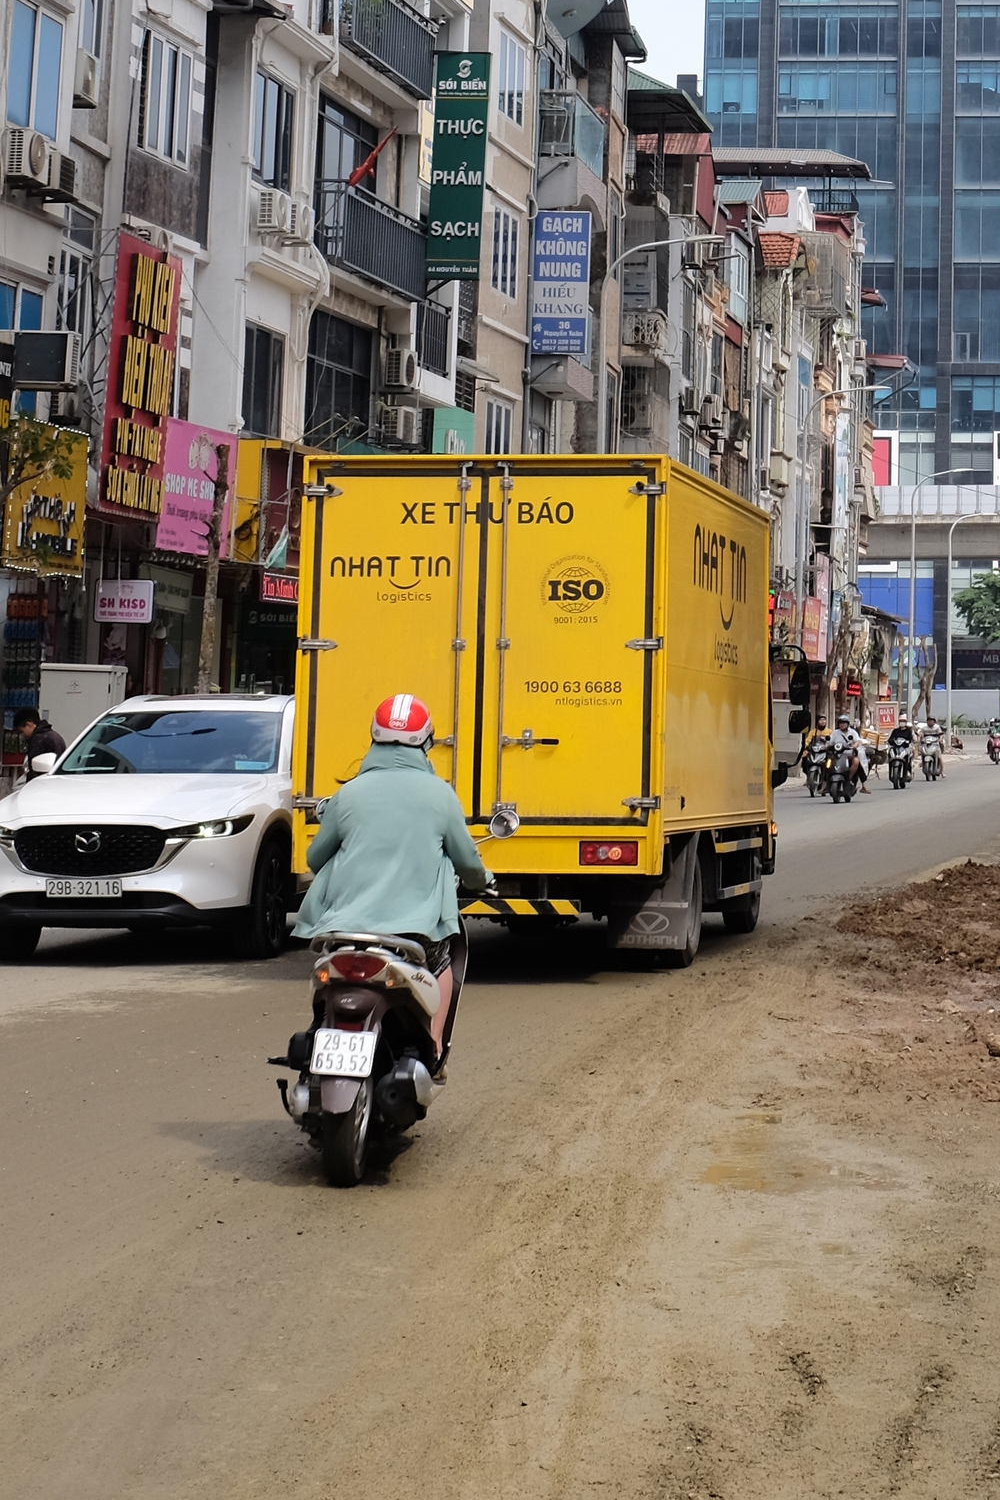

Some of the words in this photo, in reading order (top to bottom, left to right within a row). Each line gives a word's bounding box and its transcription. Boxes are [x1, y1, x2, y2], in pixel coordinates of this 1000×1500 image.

[438, 77, 457, 90] SÓI
[436, 117, 484, 138] THỰC
[433, 161, 482, 186] PHẨM
[430, 221, 480, 241] SẠCH
[542, 216, 582, 235] GẠCH
[535, 237, 587, 256] KHÔNG
[539, 261, 581, 277] NUNG
[542, 282, 576, 298] HIẾU
[534, 303, 583, 314] KHANG
[558, 321, 570, 329] 36
[165, 472, 186, 495] SHOP
[400, 502, 435, 524] XE
[517, 496, 574, 524] BÁO
[376, 591, 432, 603] logistics
[548, 579, 604, 601] ISO
[99, 598, 115, 608] SH
[119, 598, 146, 609] KISD
[982, 654, 999, 664] MB
[525, 681, 559, 693] 1900
[563, 681, 581, 693] 63
[585, 681, 622, 693] 6688
[555, 696, 623, 707] ntlogistics.vn
[48, 881, 120, 896] 29B-321.16
[323, 1033, 365, 1052] 29-G1
[315, 1053, 368, 1073] 653.52
